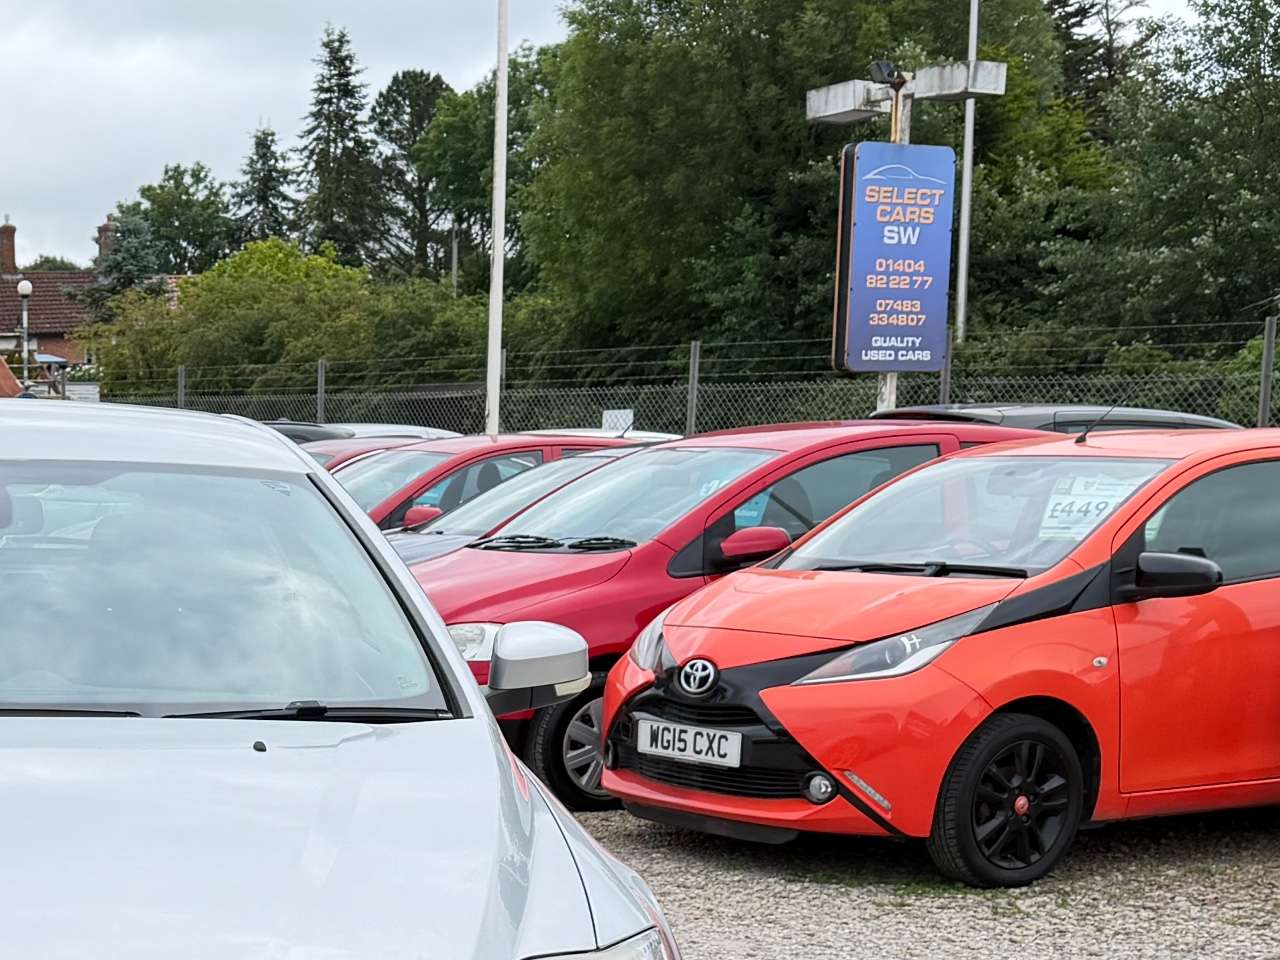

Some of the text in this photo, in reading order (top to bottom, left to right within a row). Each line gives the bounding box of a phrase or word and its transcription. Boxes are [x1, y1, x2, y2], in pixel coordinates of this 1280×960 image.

[864, 185, 945, 206] SELECT
[876, 205, 934, 224] CARS
[883, 225, 920, 245] SW
[875, 258, 925, 273] 01404
[876, 299, 921, 312] 07483
[869, 313, 926, 326] 334807
[871, 336, 922, 347] QUALITY
[861, 350, 931, 361] USED CARS
[1048, 501, 1118, 519] £449
[649, 724, 729, 759] WG15 CXC
